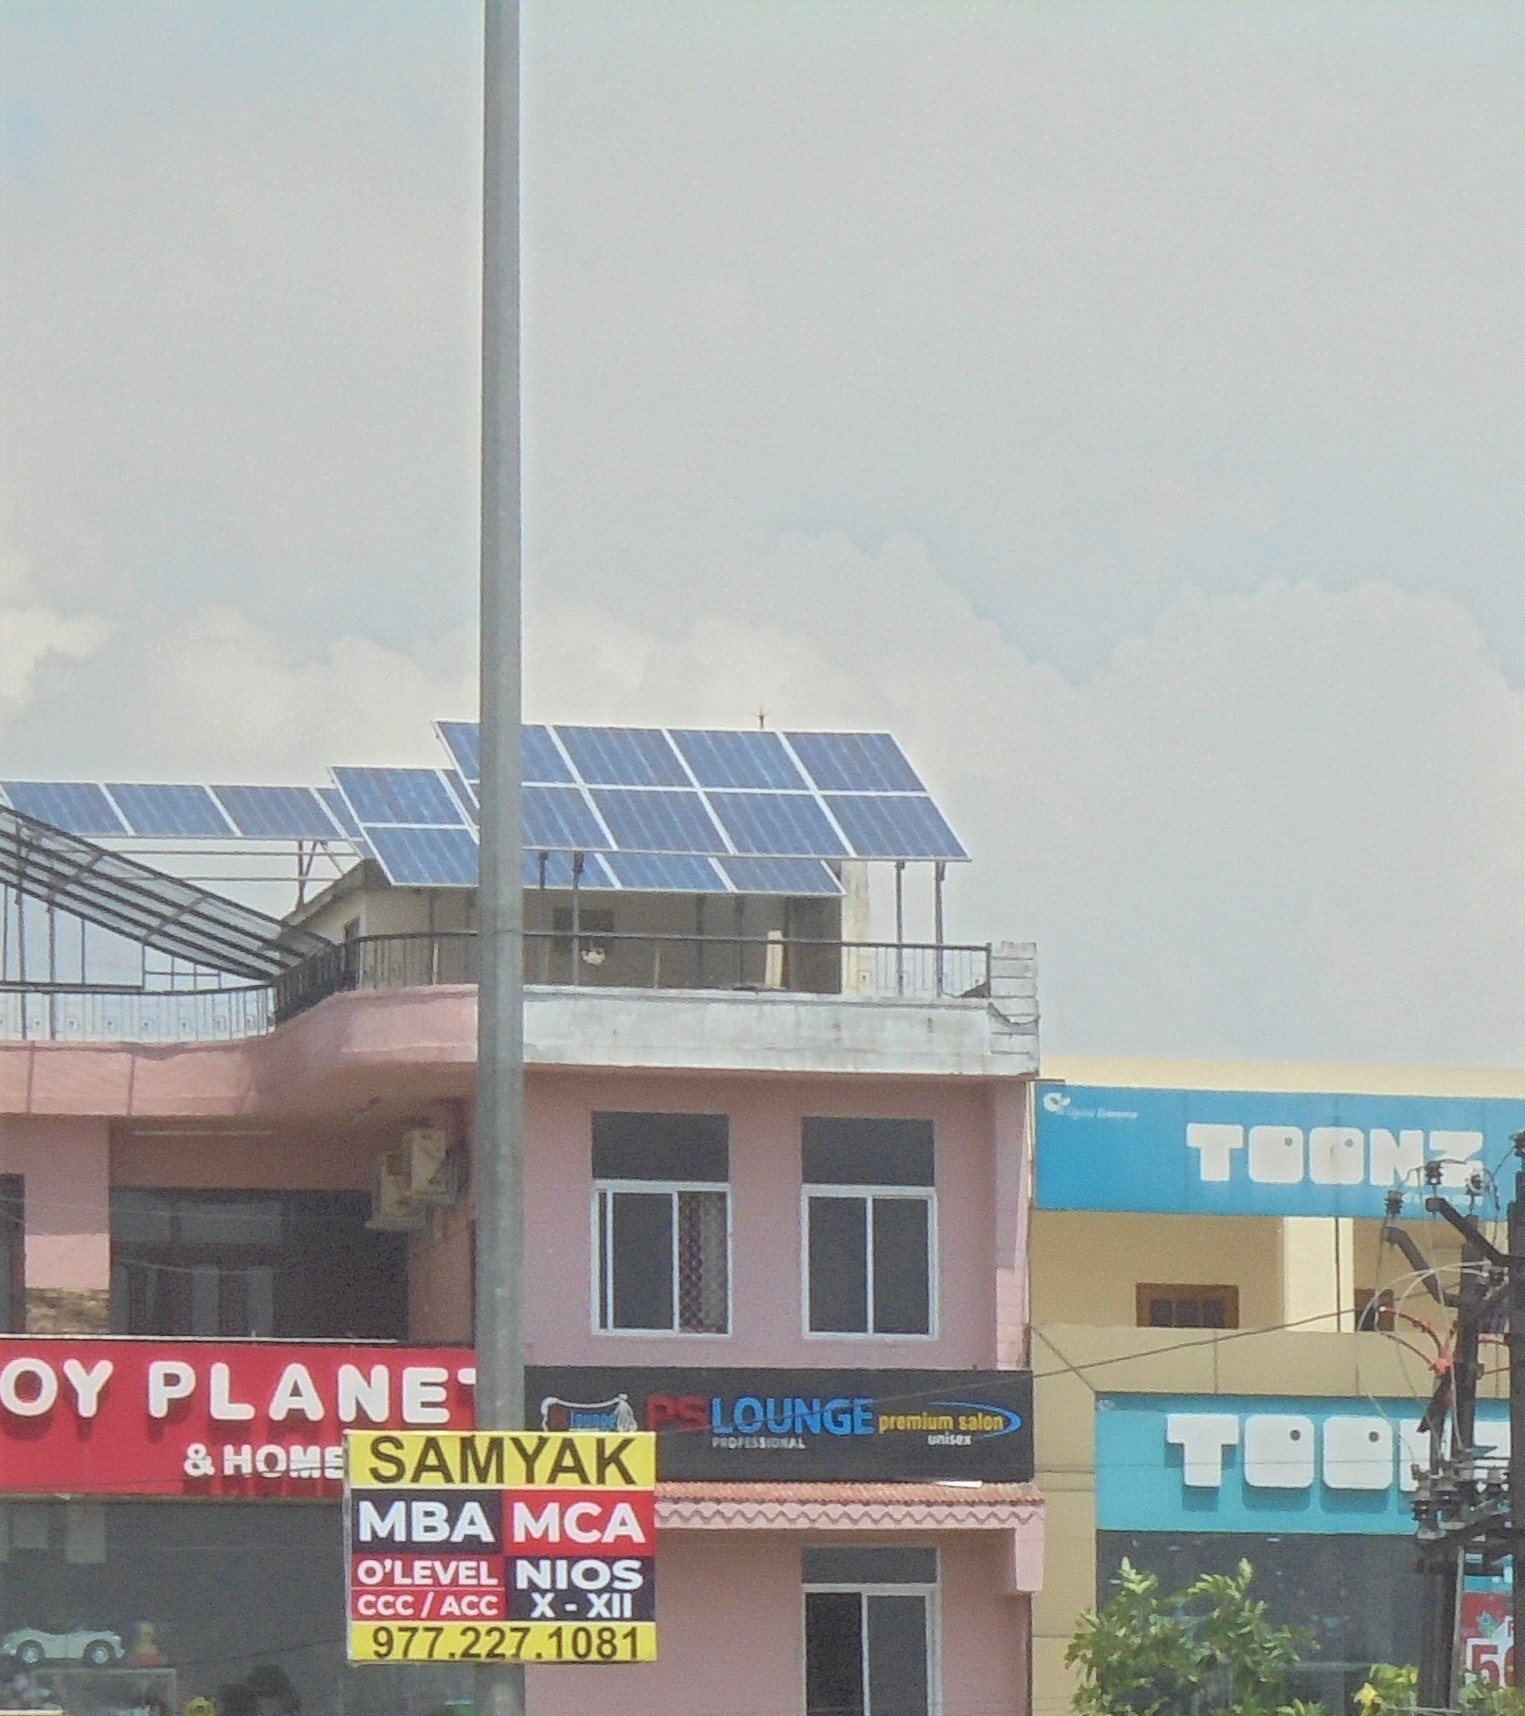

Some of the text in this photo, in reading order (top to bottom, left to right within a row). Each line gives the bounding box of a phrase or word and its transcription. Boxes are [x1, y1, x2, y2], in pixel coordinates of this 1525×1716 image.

[1186, 1122, 1484, 1188] TOONZ
[147, 1361, 476, 1425] PLANE
[711, 1396, 876, 1436] LOUNGE
[878, 1412, 954, 1434] premium
[958, 1411, 1005, 1432] salon
[183, 1442, 345, 1480] & HOME
[368, 1434, 637, 1485] SAMYAK
[358, 1500, 495, 1543] MBA
[513, 1501, 647, 1544] MCA
[357, 1558, 499, 1586] O'LEVEL
[515, 1559, 644, 1590] NIOS
[357, 1594, 415, 1616] CCC
[439, 1594, 499, 1616] ACC
[530, 1592, 555, 1618] X
[586, 1592, 633, 1618] XII
[372, 1626, 639, 1660] 977.227.1081
